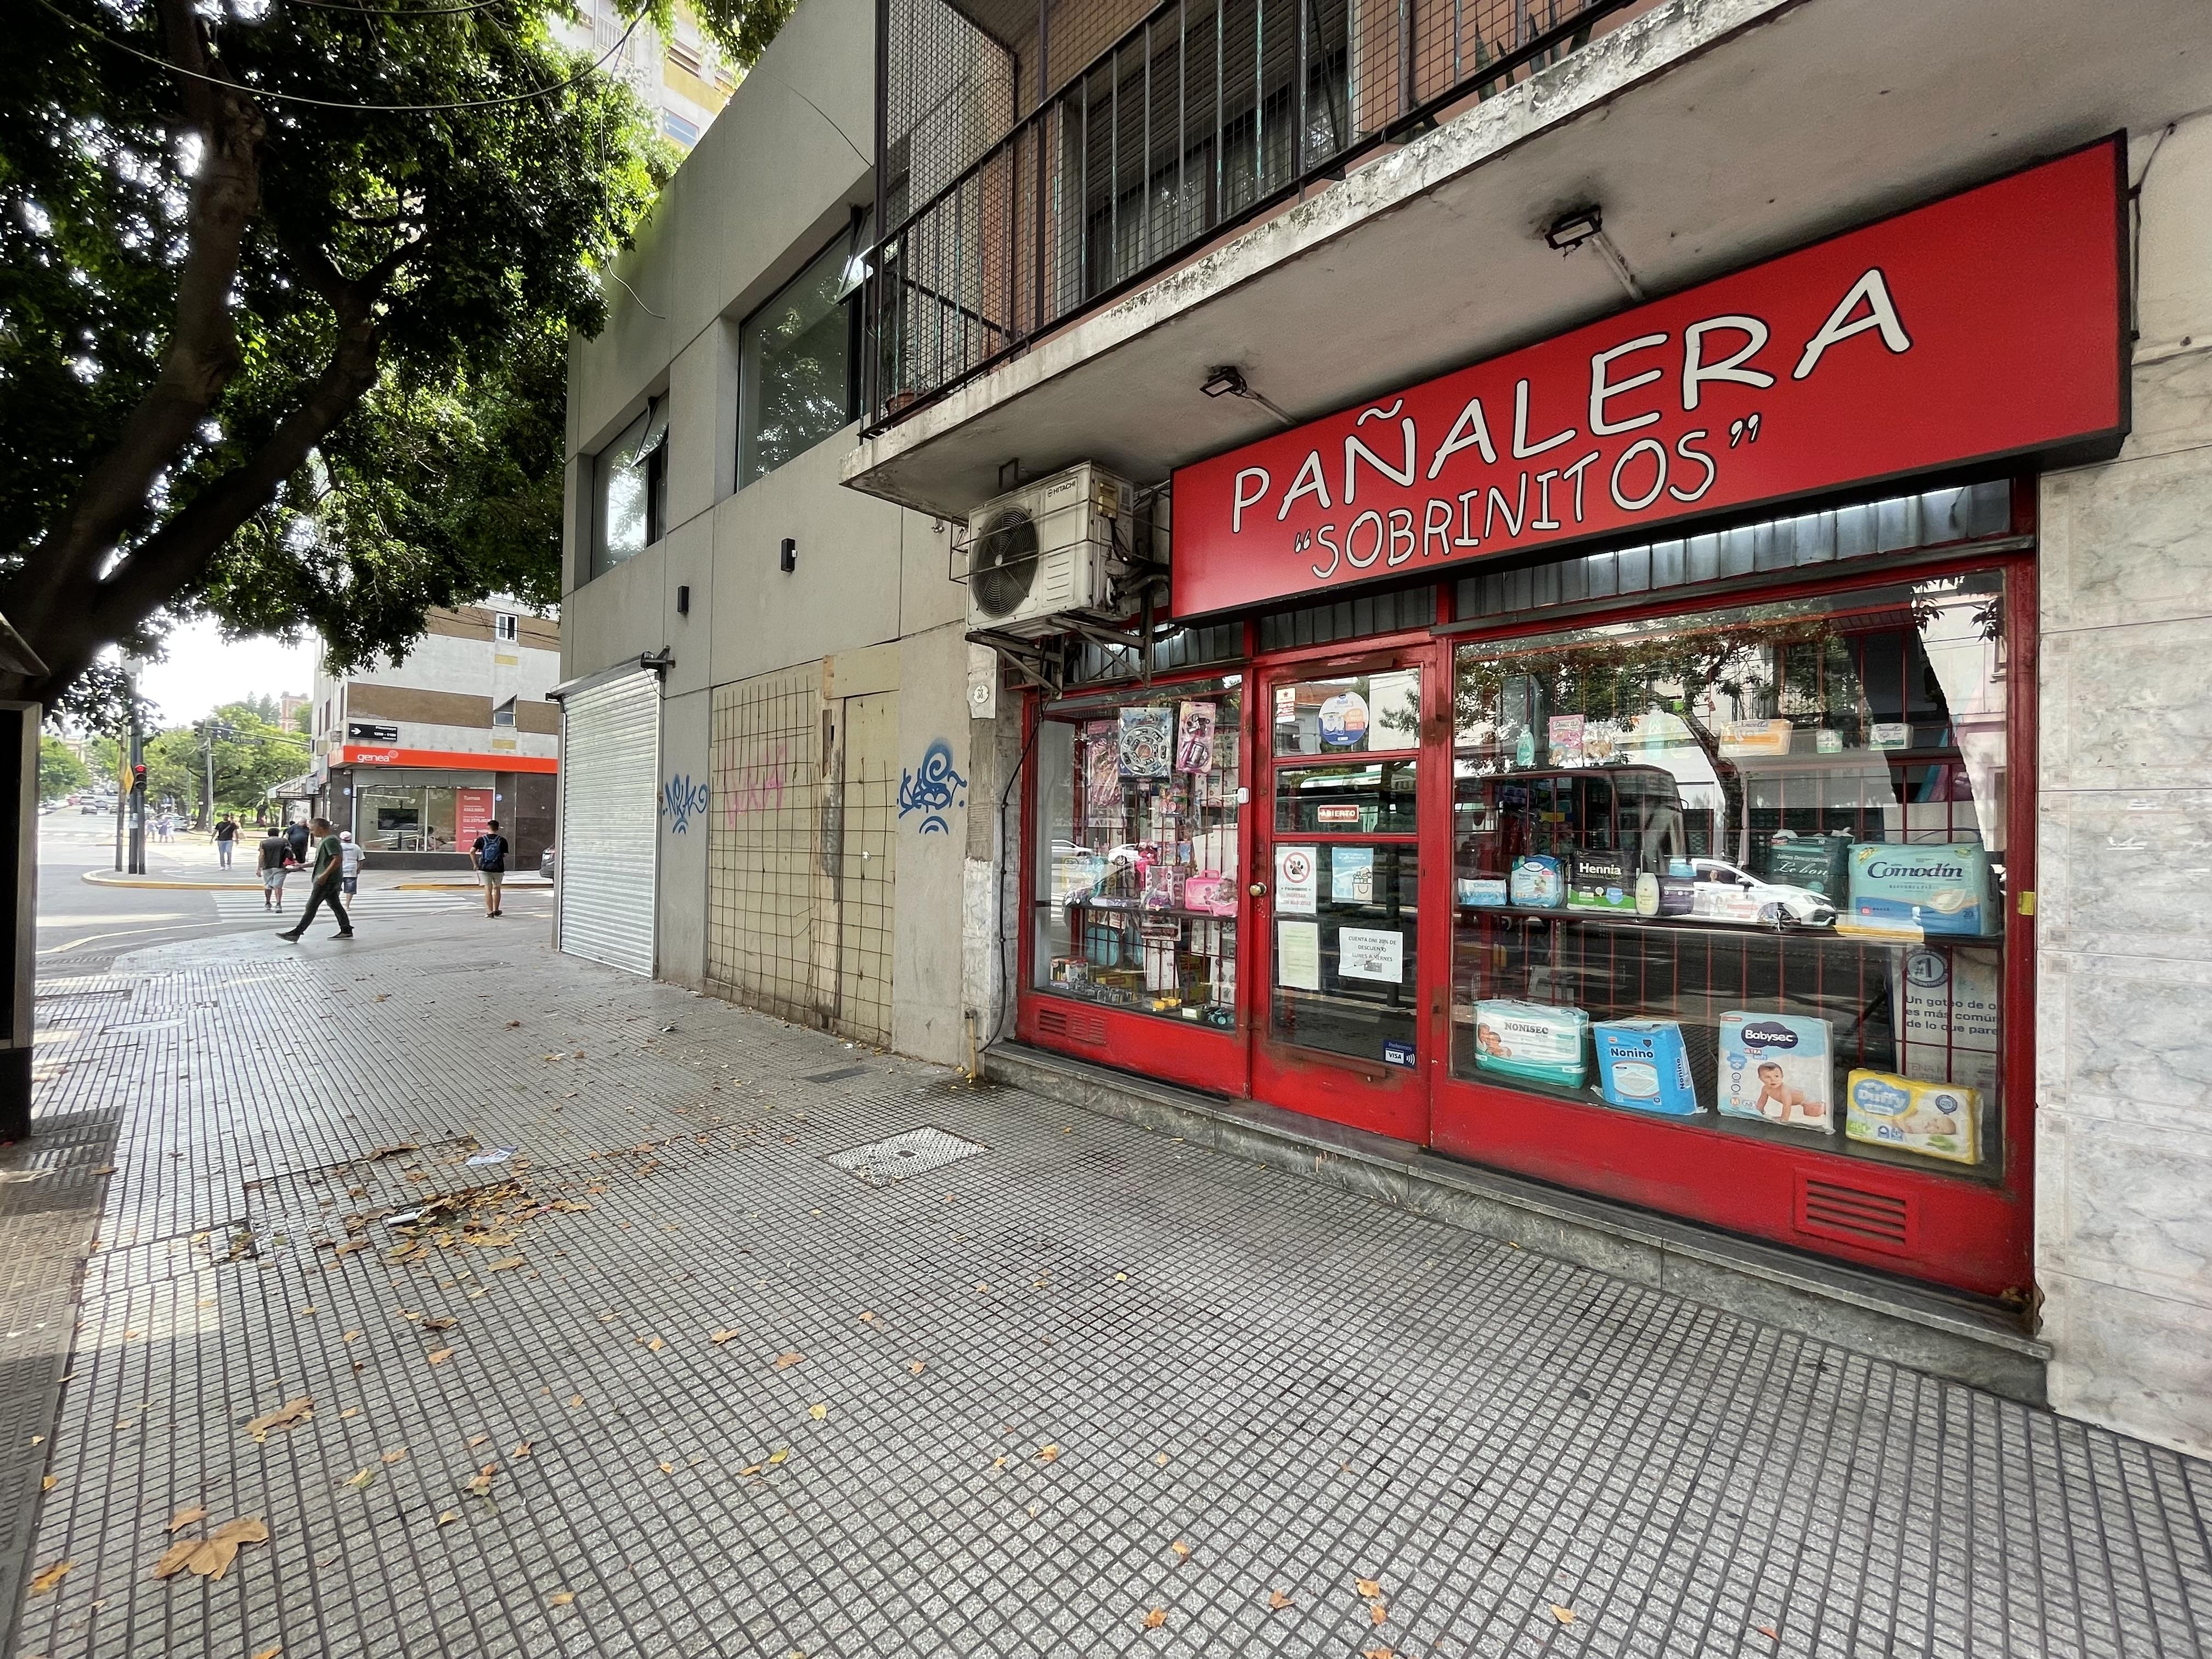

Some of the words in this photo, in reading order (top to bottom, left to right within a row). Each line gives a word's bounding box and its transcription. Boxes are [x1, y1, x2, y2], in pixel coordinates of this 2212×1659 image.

[1232, 267, 1914, 534] PAÑALERA
[1053, 480, 1076, 494] HITACHI
[977, 689, 984, 699] 38
[357, 754, 390, 763] genea
[1579, 862, 1622, 875] Hennia
[1774, 861, 1796, 873] Le
[1799, 863, 1829, 876] bon
[1867, 861, 1962, 878] Comodín
[1915, 957, 1932, 978] #1
[1905, 996, 1922, 1004] Un
[1927, 998, 1963, 1008] goto
[1967, 1000, 1984, 1009] de
[1504, 1022, 1549, 1034] NONISEC
[1926, 1021, 1937, 1029] lo
[1745, 1029, 1793, 1042] Babysec
[1611, 1048, 1654, 1058] Nonino
[1676, 1058, 1685, 1090] Nonino
